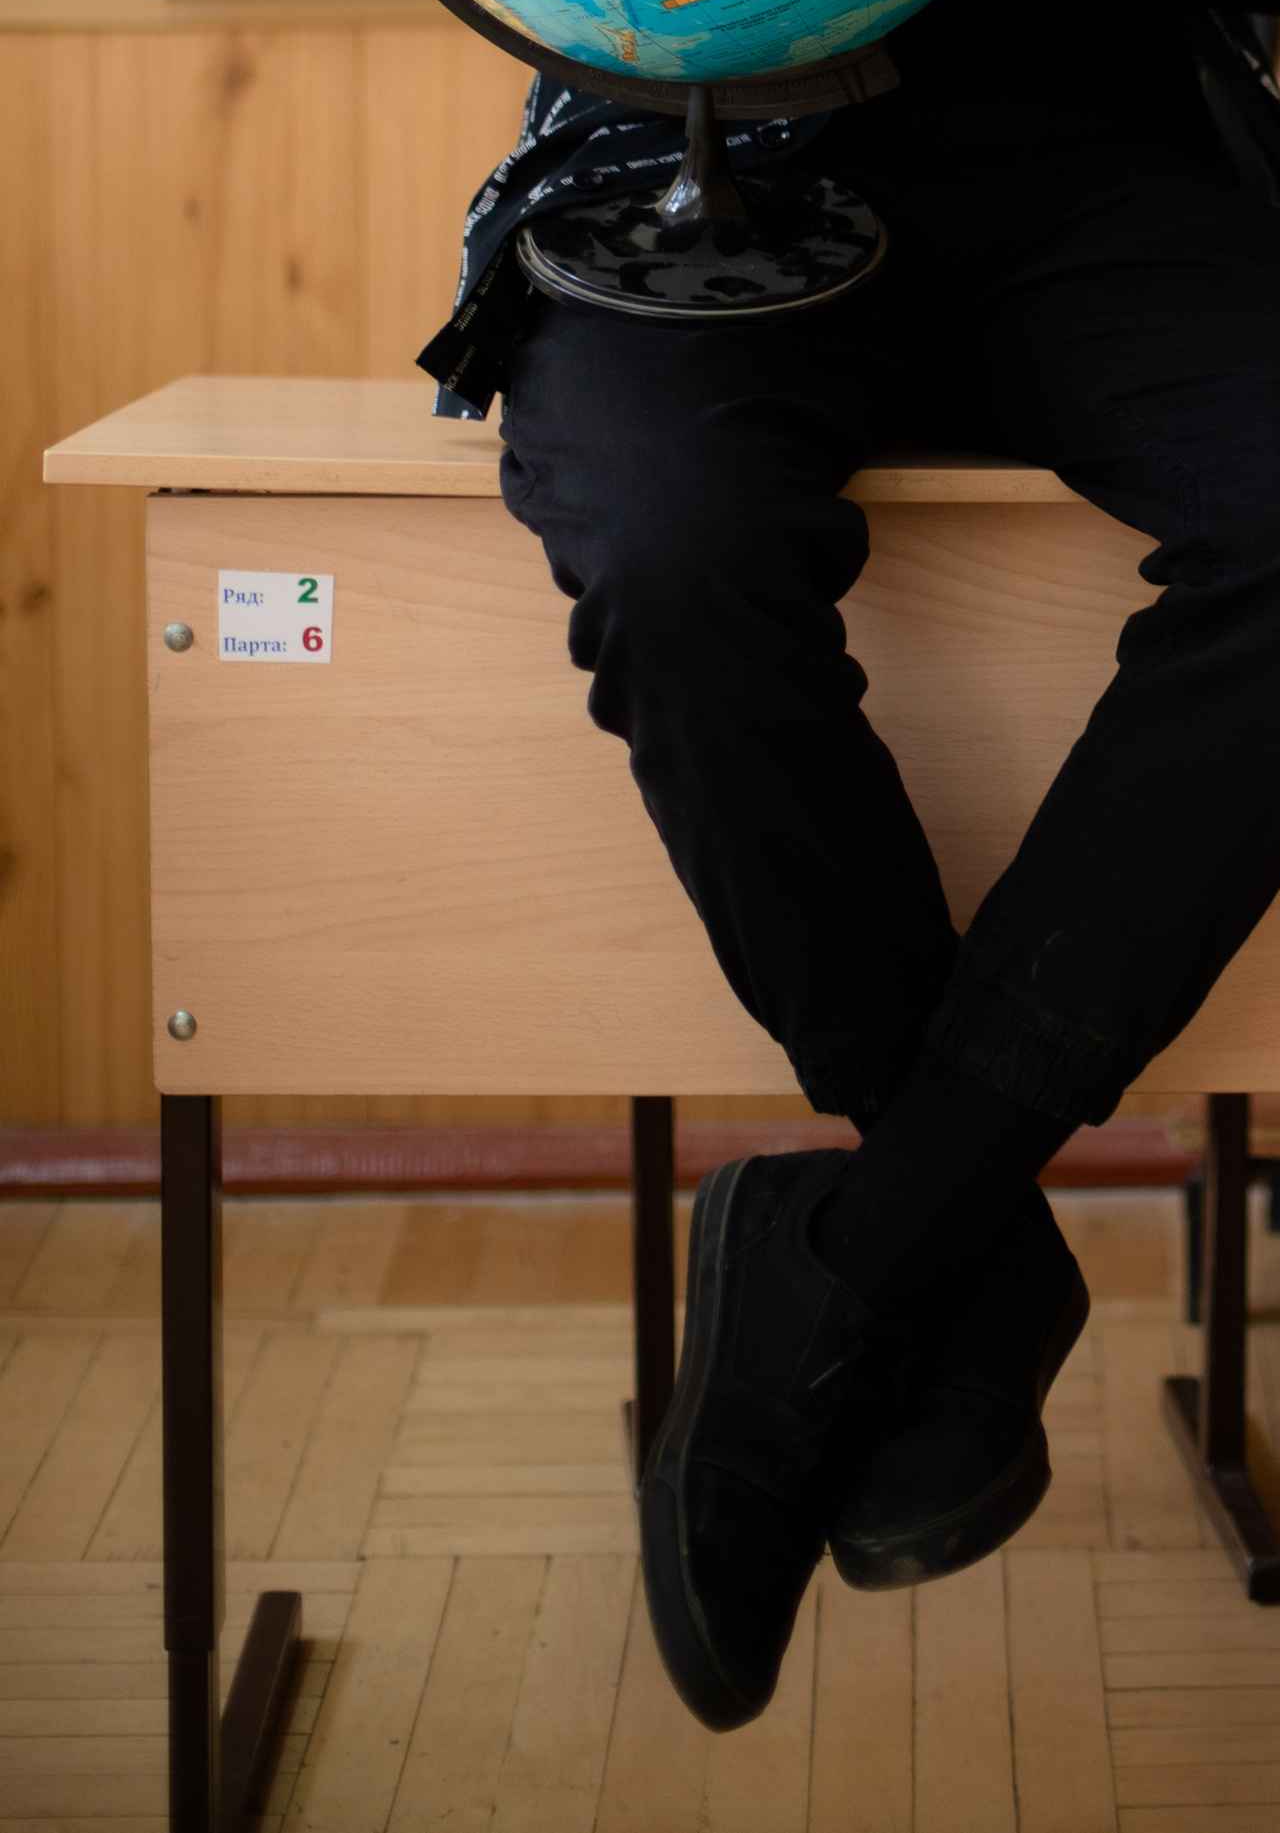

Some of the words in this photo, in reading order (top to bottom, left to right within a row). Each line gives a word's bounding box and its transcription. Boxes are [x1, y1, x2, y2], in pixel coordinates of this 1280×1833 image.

[475, 186, 500, 215] SQUAD
[222, 588, 265, 606] Ряд:
[297, 577, 319, 604] 2
[223, 636, 287, 657] Парта:
[302, 626, 324, 652] 6
